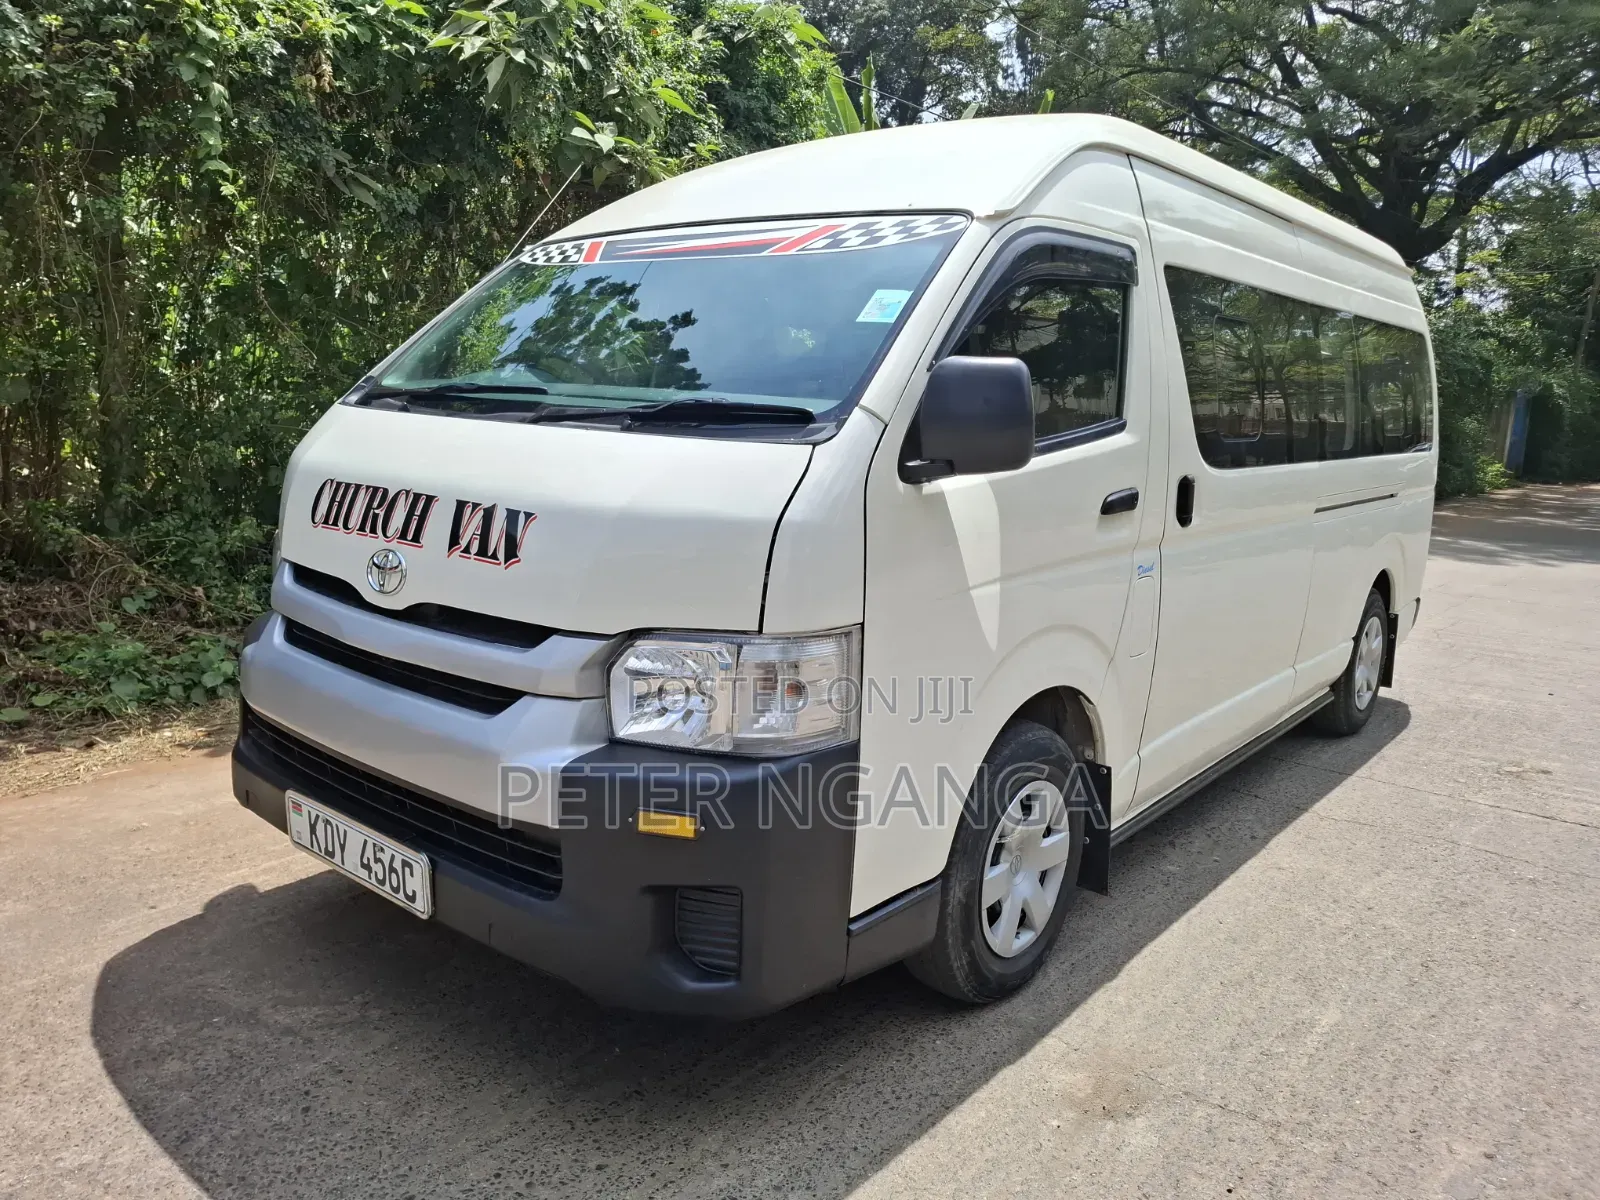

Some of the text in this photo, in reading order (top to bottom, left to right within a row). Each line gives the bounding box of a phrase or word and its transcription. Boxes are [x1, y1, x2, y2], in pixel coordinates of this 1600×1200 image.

[310, 477, 538, 570] CHURCH VAN
[307, 809, 417, 904] KDY 456C
